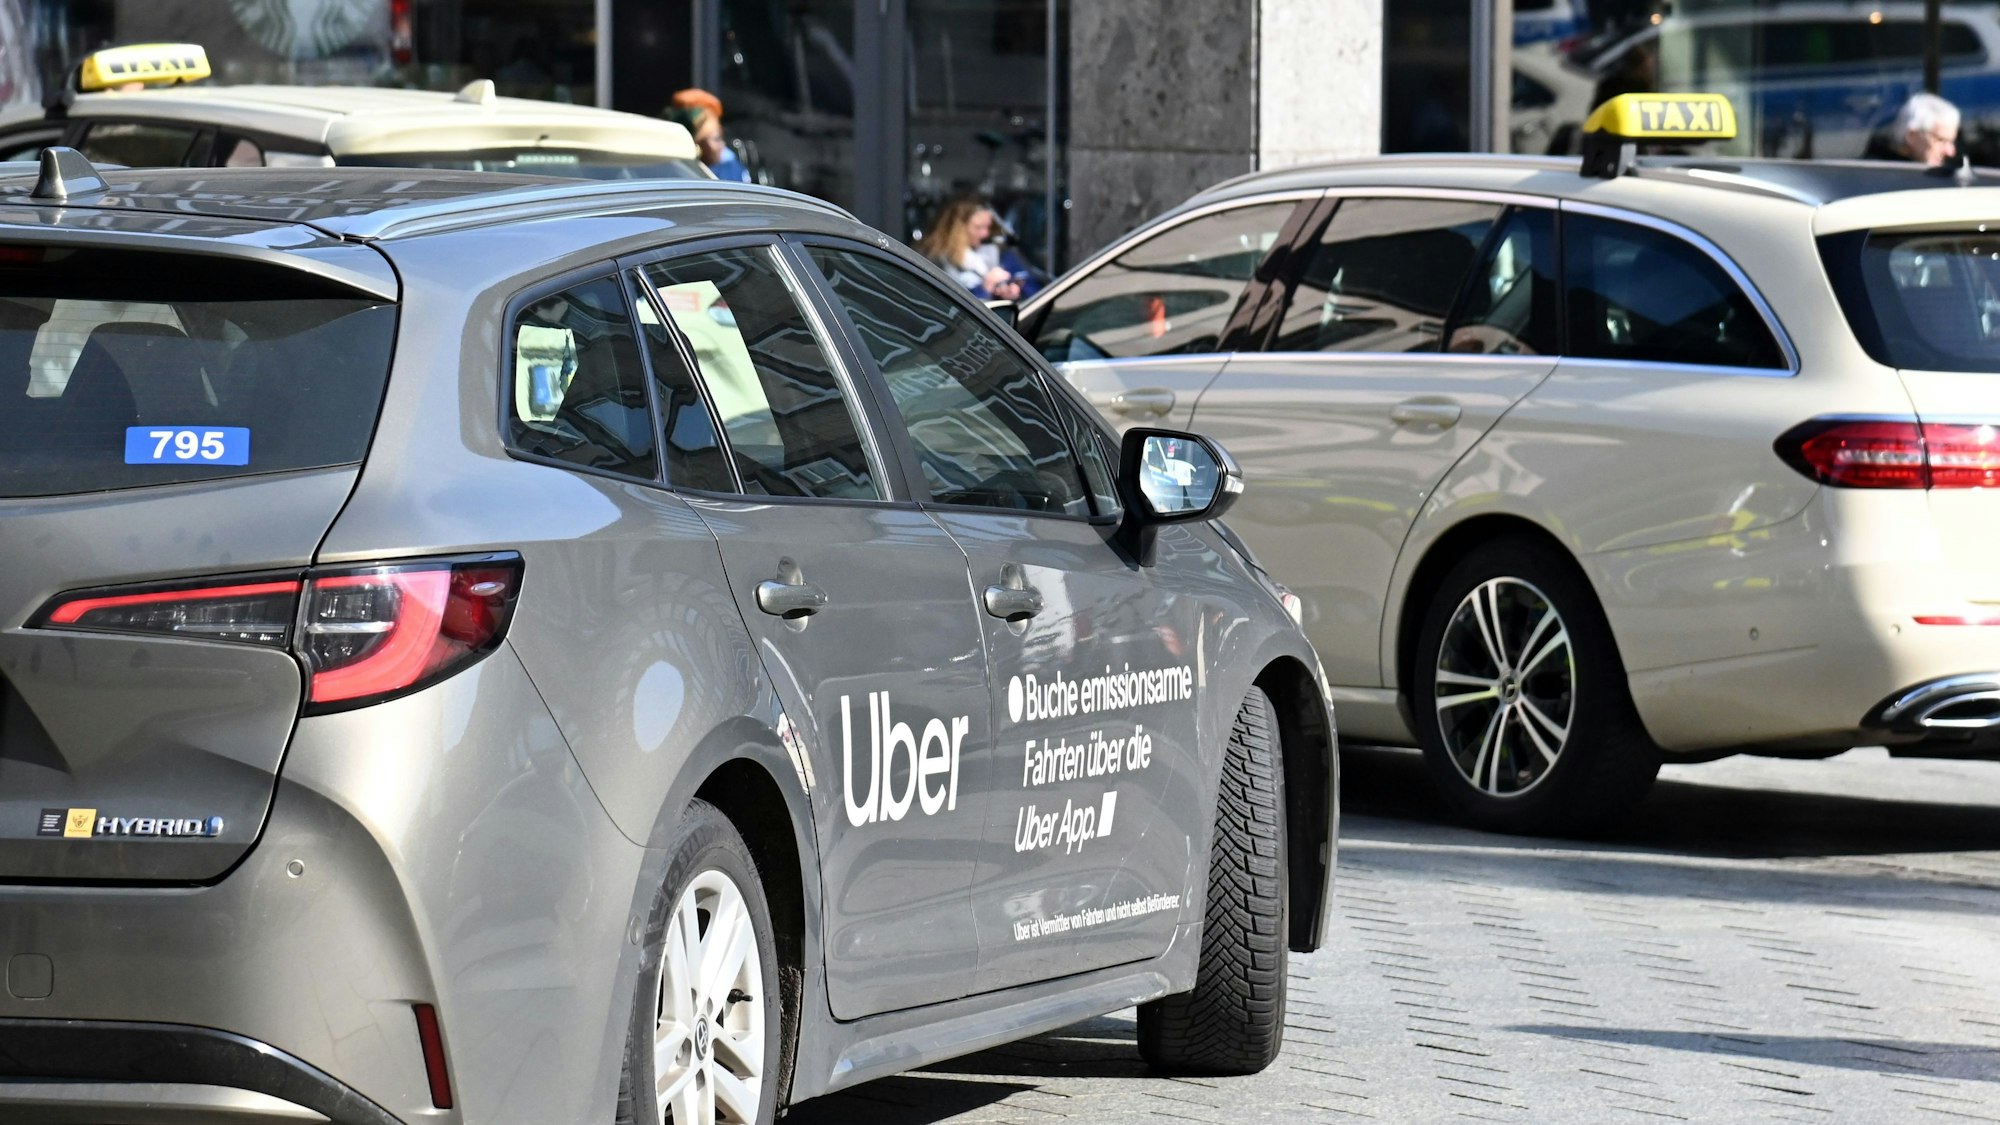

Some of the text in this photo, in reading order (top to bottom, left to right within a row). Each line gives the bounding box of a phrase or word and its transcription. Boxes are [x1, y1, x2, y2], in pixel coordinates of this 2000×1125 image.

[109, 57, 196, 75] TAXI
[1641, 101, 1722, 131] TAXI
[149, 430, 225, 460] 795
[1025, 662, 1192, 721] Buche emissionsarme
[840, 690, 969, 827] Uber
[1023, 724, 1152, 787] Fahrten über die
[96, 816, 203, 836] HYBRID
[1015, 798, 1095, 855] Uber App.
[1013, 921, 1030, 941] Uber
[1029, 919, 1040, 938] ist
[1038, 913, 1071, 936] Vermittler
[1070, 914, 1083, 930] von
[1081, 907, 1105, 927] Fahrten
[1104, 902, 1117, 922] und
[1116, 900, 1131, 920] nicht
[1130, 897, 1147, 917] selbst
